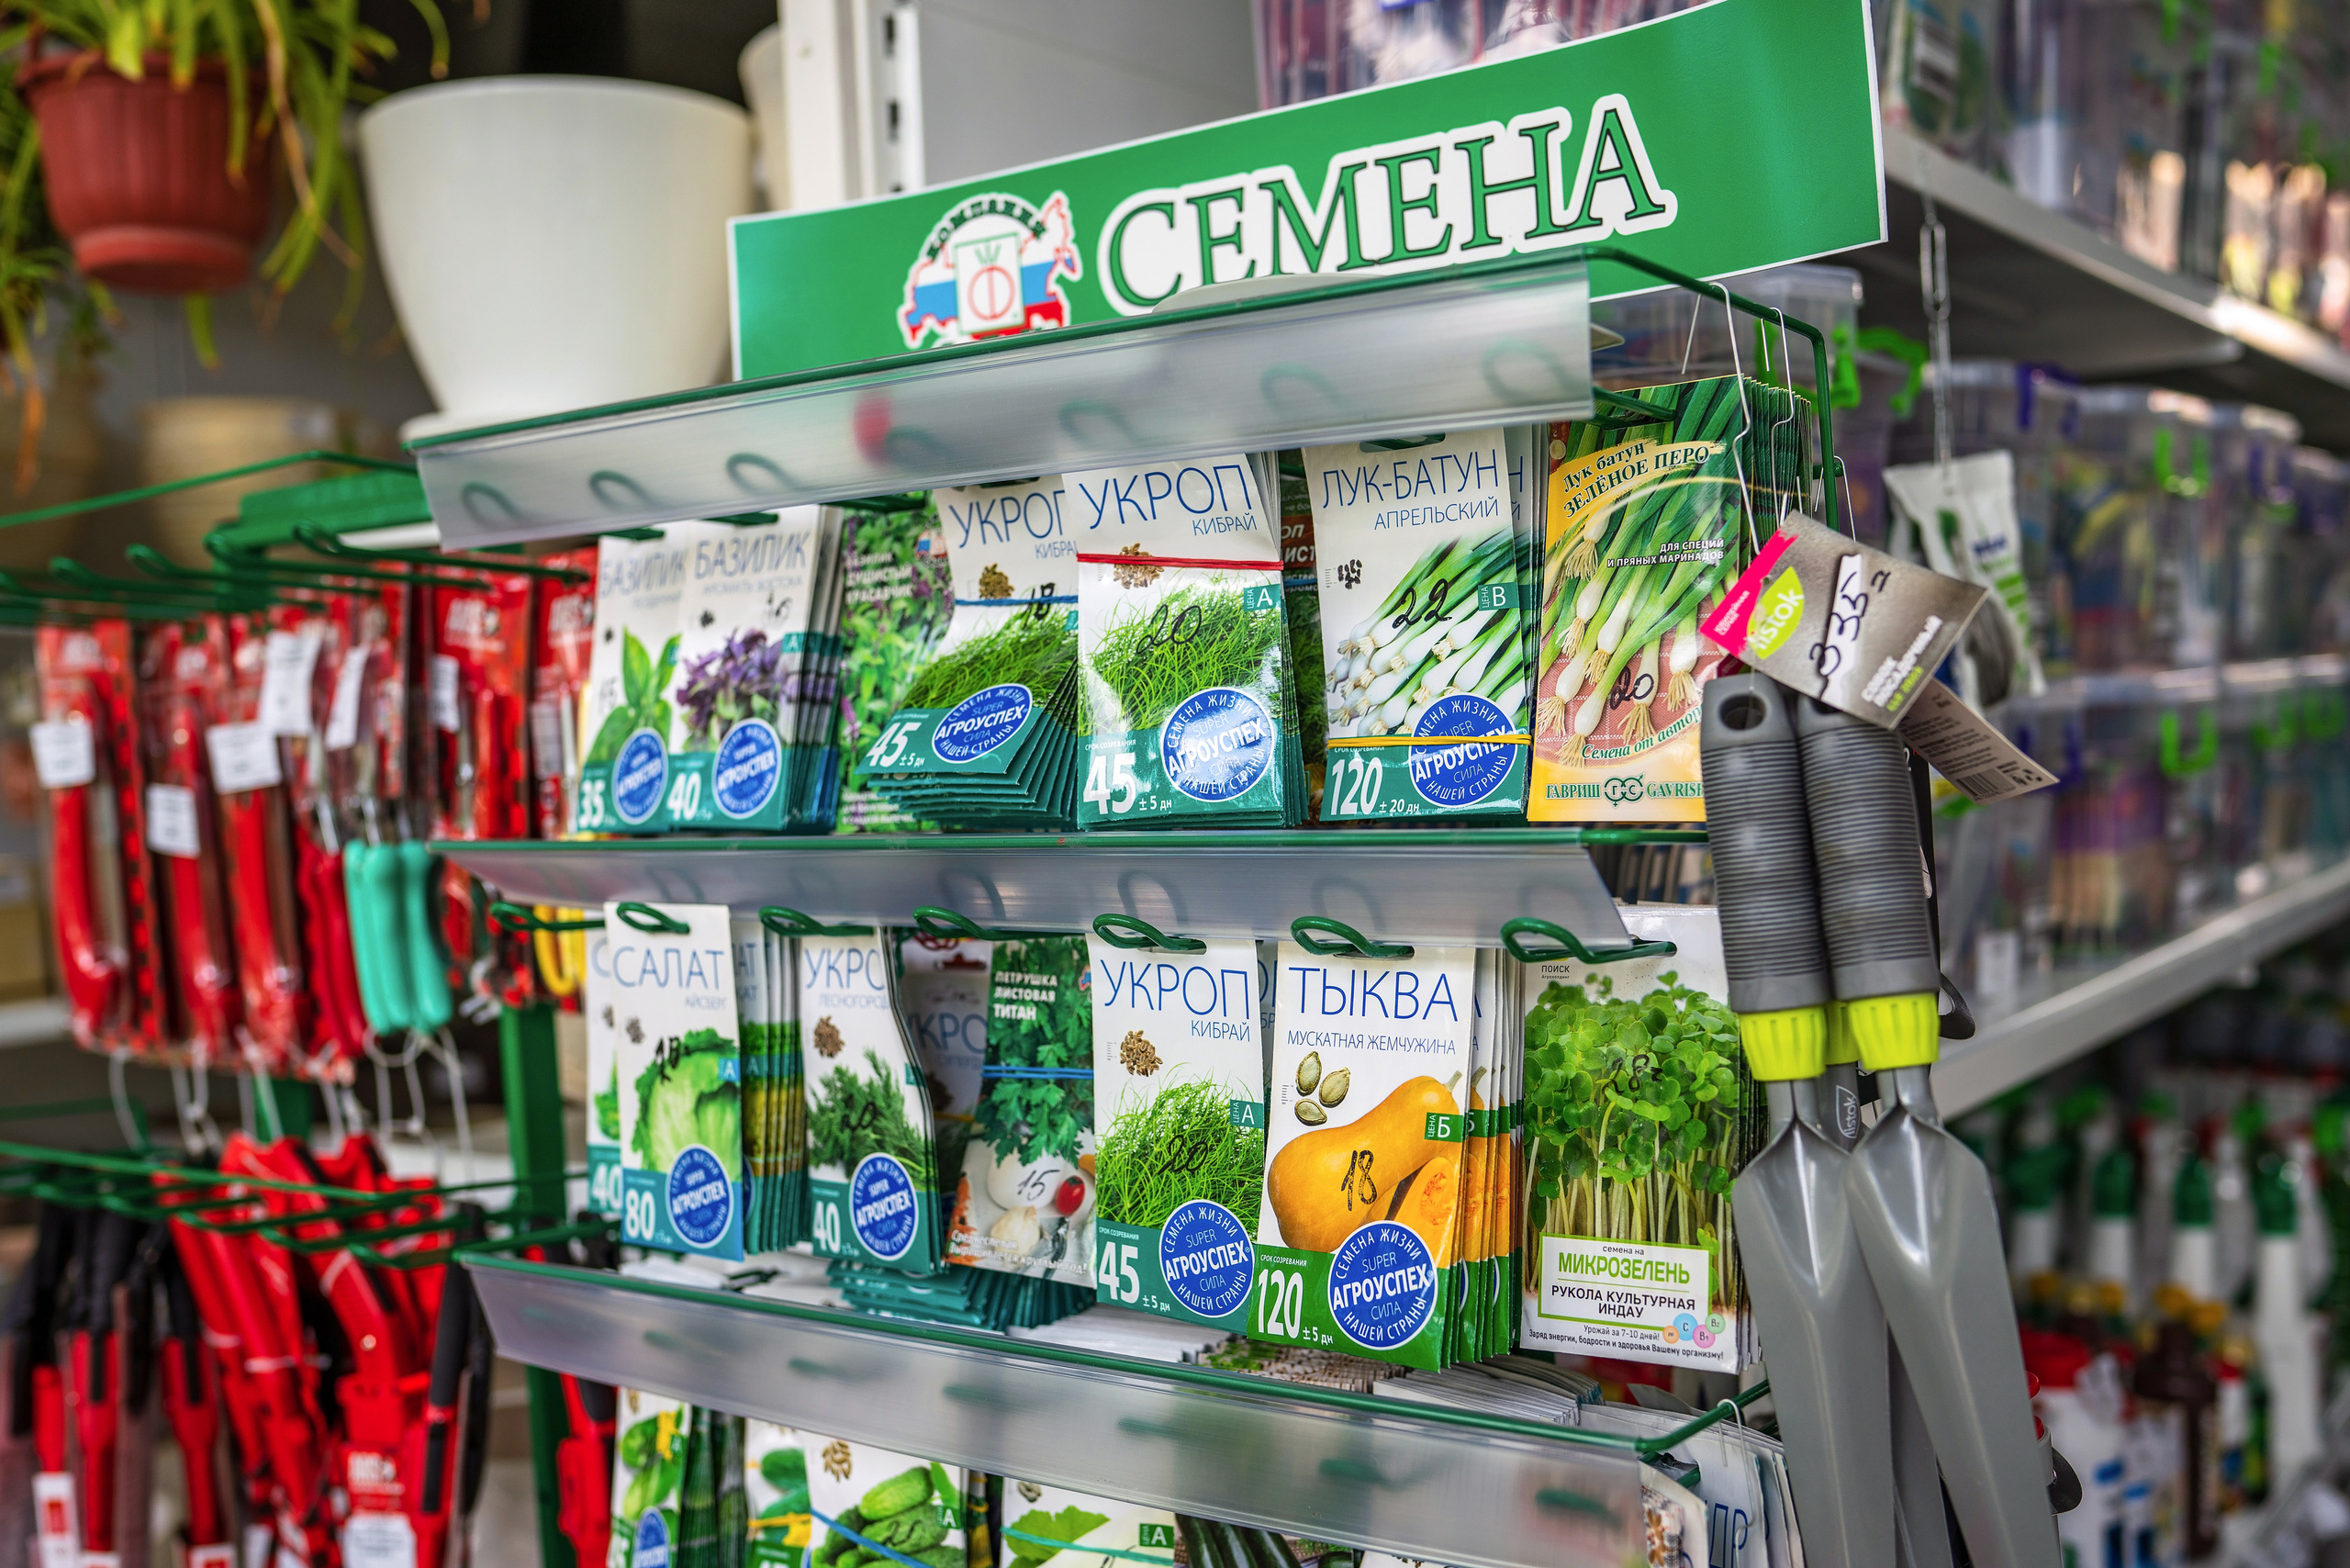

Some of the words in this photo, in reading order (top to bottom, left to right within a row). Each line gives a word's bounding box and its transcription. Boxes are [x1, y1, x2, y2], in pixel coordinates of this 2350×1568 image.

[1108, 107, 1666, 308] СЕМЕНА
[927, 198, 1046, 263] КОМПАНИЯ
[1322, 449, 1499, 509] ЛУК-БАТУН
[1562, 469, 1593, 493] Лук
[1595, 442, 1646, 471] батун
[1562, 458, 1650, 519] ЗЕЛЁНОЕ
[1653, 446, 1710, 471] ПЕРО
[1078, 465, 1252, 530] УКРОП
[1373, 496, 1499, 531] АПРЕЛЬСКИЙ
[1192, 512, 1258, 536] КИБРАЙ
[694, 531, 810, 580] БАЗИЛИК
[1607, 559, 1615, 567] И
[1616, 555, 1657, 567] ПРЯНЫХ
[1659, 550, 1725, 565] МАРИНАДОВ
[1660, 543, 1680, 554] ДЛЯ
[1681, 538, 1725, 552] СПЕЦИЙ
[1246, 588, 1255, 610] ЦЕНА
[1256, 588, 1273, 608] А
[1392, 577, 1453, 630] 22
[1492, 586, 1506, 608] В
[1743, 588, 1806, 650] listok
[947, 690, 992, 722] СЕМЕНА
[995, 687, 1025, 704] ЖИЗНИ
[970, 700, 1004, 717] SUPER
[1168, 700, 1203, 748] СЕМЕНА
[1207, 694, 1254, 718] ЖИЗНИ
[934, 704, 1026, 741] АГРОУСПЕХ
[938, 739, 969, 757] НАШЕЙ
[970, 723, 1014, 755] СТРАНЫ
[963, 730, 991, 743] СИЛА
[1193, 713, 1231, 738] SUPER
[1415, 706, 1449, 755] СМЕНА
[1450, 700, 1498, 724] ЖИЗНИ
[1438, 720, 1474, 738] SUPER
[866, 722, 922, 767] 45
[908, 752, 916, 766] 5
[914, 756, 925, 767] дн
[1085, 743, 1100, 751] СРОК
[1100, 739, 1136, 750] СОЗРЕВАНИЯ
[1169, 717, 1268, 777] АГРОУСПЕХ
[1415, 724, 1513, 782] АГРОУСПЕХ
[1581, 744, 1631, 760] Семена
[1634, 734, 1654, 752] от
[1082, 752, 1137, 815] 45
[1149, 796, 1158, 811] 5
[1159, 799, 1172, 812] дн
[1182, 773, 1227, 796] НАШЕЙ
[1229, 746, 1266, 790] СТРАНЫ
[1210, 755, 1240, 777] СИЛА
[1426, 780, 1466, 801] НАШЕЙ
[1469, 755, 1508, 796] СТРАНЫ
[1453, 763, 1485, 784] СИЛА
[578, 778, 606, 829] 35
[666, 771, 701, 821] 40
[1330, 756, 1383, 816] 120
[1389, 798, 1405, 813] 20
[1406, 801, 1420, 815] дн
[1545, 783, 1601, 800] ГАВРИШ
[612, 945, 725, 990] САЛАТ
[994, 970, 1058, 987] ПЕТРУШКА
[1541, 965, 1570, 973] ПОИСК
[993, 986, 1057, 1003] ЛИСТОВАЯ
[1100, 959, 1249, 1020] УКРОП
[1288, 967, 1459, 1023] ТЫКВА
[992, 1003, 1037, 1021] ТИТАН
[1191, 1019, 1250, 1043] КИБРАЙ
[1287, 1029, 1364, 1050] МУСКАТНАЯ
[1366, 1034, 1457, 1056] ЖЕМЧУЖИНА
[1240, 1103, 1255, 1125] А
[1427, 1114, 1436, 1138] ЦЕНА
[1437, 1116, 1451, 1139] Б
[1842, 1095, 1856, 1137] listok
[591, 1162, 622, 1210] 40
[1340, 1149, 1378, 1212] 18
[625, 1187, 656, 1241] 80
[856, 1188, 912, 1229] АГРОУСПЕХ
[812, 1200, 841, 1254] 40
[1098, 1226, 1110, 1236] СРОК
[1110, 1229, 1140, 1241] СОЗРЕВАНИЯ
[1164, 1209, 1195, 1254] СЕМЕНА
[1198, 1206, 1238, 1238] ЖИЗНИ
[1185, 1228, 1217, 1249] SUPER
[1165, 1239, 1249, 1282] АГРОУСПЕХ
[1260, 1254, 1274, 1262] СРОК
[1273, 1256, 1308, 1268] СОЗРЕВАНИЯ
[1336, 1231, 1376, 1280] СЕМЕНА
[1380, 1227, 1423, 1260] ЖИЗНИ
[1361, 1251, 1398, 1273] SUPER
[1558, 1252, 1690, 1284] МИКРОЗЕЛЕНЬ
[1602, 1245, 1633, 1255] семена
[1635, 1248, 1645, 1256] на
[1098, 1241, 1141, 1305] 45
[1151, 1295, 1158, 1309] 5
[1159, 1301, 1170, 1313] дн
[1177, 1282, 1214, 1311] НАШЕЙ
[1215, 1270, 1248, 1309] СТРАНЫ
[1199, 1274, 1227, 1292] СИЛА
[1332, 1263, 1431, 1311] АГРОУСПЕХ
[1258, 1268, 1304, 1340] 120
[1312, 1327, 1319, 1342] 5
[1321, 1333, 1334, 1345] дн
[1371, 1301, 1403, 1321] СИЛА
[1551, 1284, 1605, 1302] РУКОЛА
[1606, 1290, 1695, 1311] КУЛЬТУРНАЯ
[1598, 1303, 1644, 1318] ИНДАУ
[1343, 1311, 1384, 1342] НАШЕЙ
[1387, 1295, 1427, 1340] СТРАНЫ
[1583, 1325, 1610, 1338] Урожай
[1621, 1328, 1639, 1338] 7-10
[1639, 1331, 1660, 1341] дней!
[1528, 1328, 1548, 1340] Заряд
[1549, 1332, 1578, 1345] энергии,
[1578, 1335, 1611, 1349] бодрости
[1617, 1340, 1651, 1352] здоровья
[1651, 1344, 1680, 1357] Вашему
[1682, 1349, 1724, 1361] организму!
[943, 1508, 957, 1528] А
[1151, 1526, 1169, 1546] А
